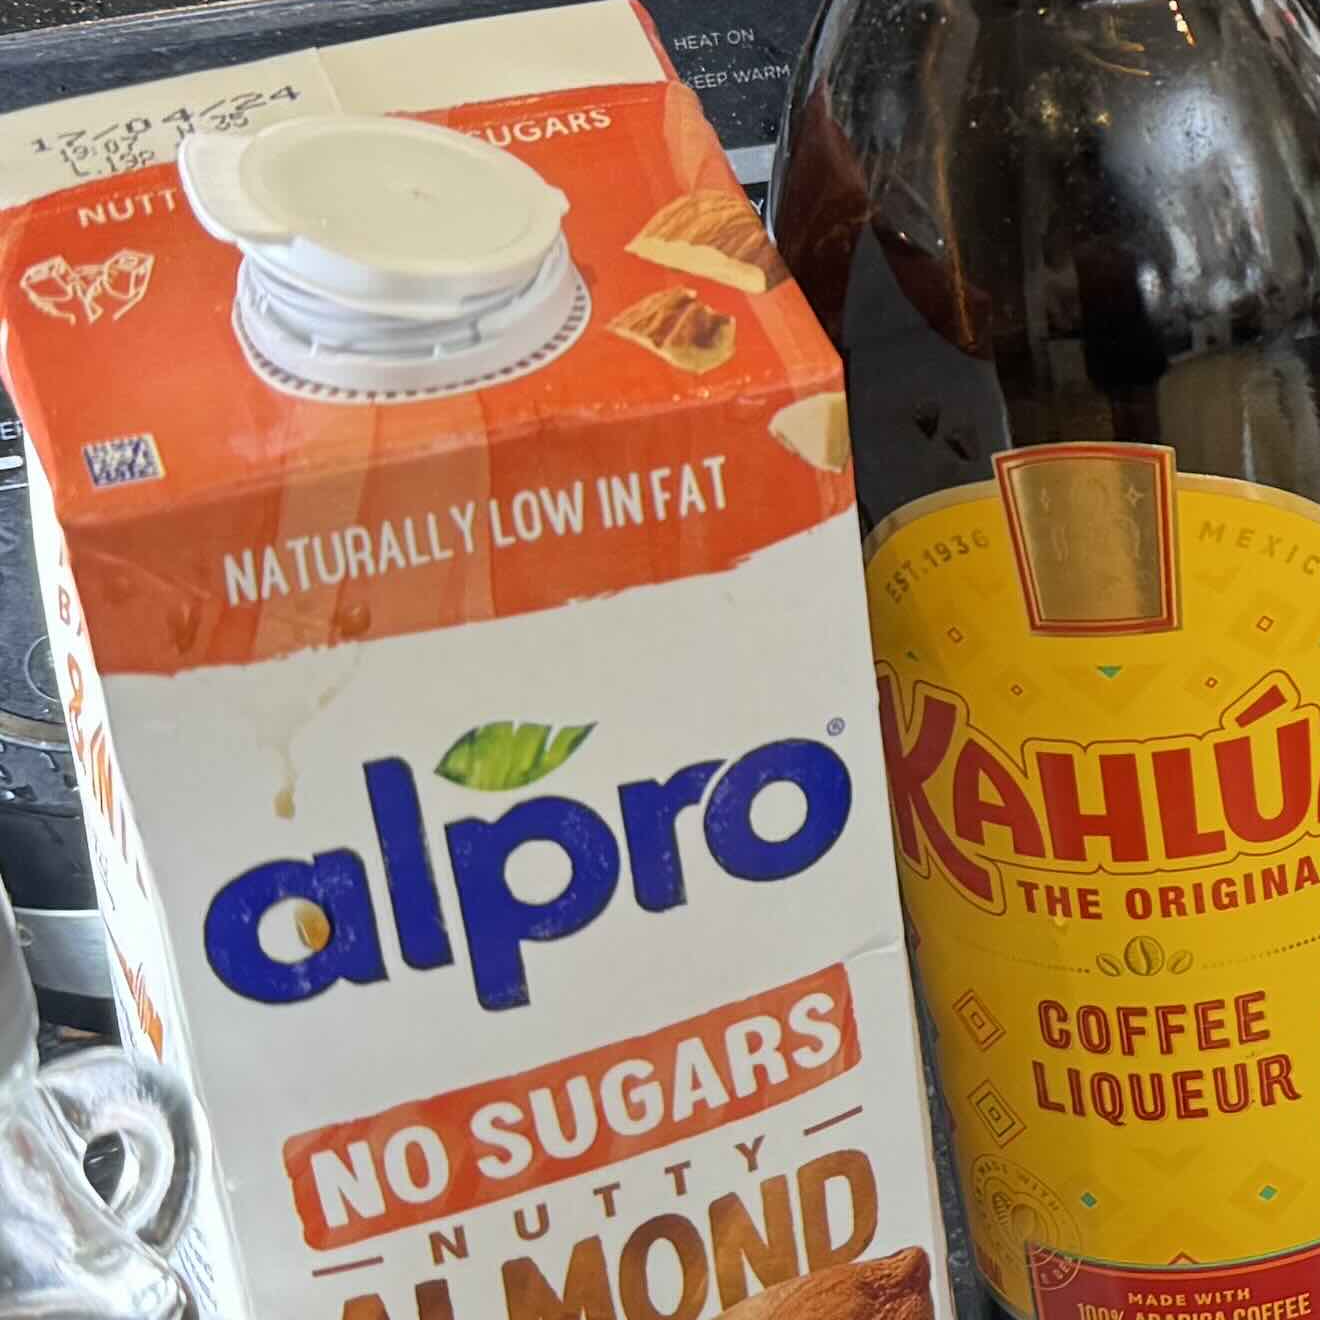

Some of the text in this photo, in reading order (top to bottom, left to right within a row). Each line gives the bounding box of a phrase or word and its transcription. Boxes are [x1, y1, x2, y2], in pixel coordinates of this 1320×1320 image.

[673, 28, 756, 51] HEAT ON
[732, 63, 792, 84] WARM
[77, 106, 612, 229] NUTT UGARS
[222, 454, 729, 610] NATURALLY LOW IN FAT
[203, 736, 853, 1014] alpro
[1017, 878, 1103, 921] THE
[1037, 989, 1271, 1057] COFFEE
[308, 990, 843, 1233] NO SUGARS
[1031, 1052, 1303, 1127] LIQUEUR
[426, 1134, 767, 1266] NUTTY
[1127, 1286, 1251, 1308] MADE WITH
